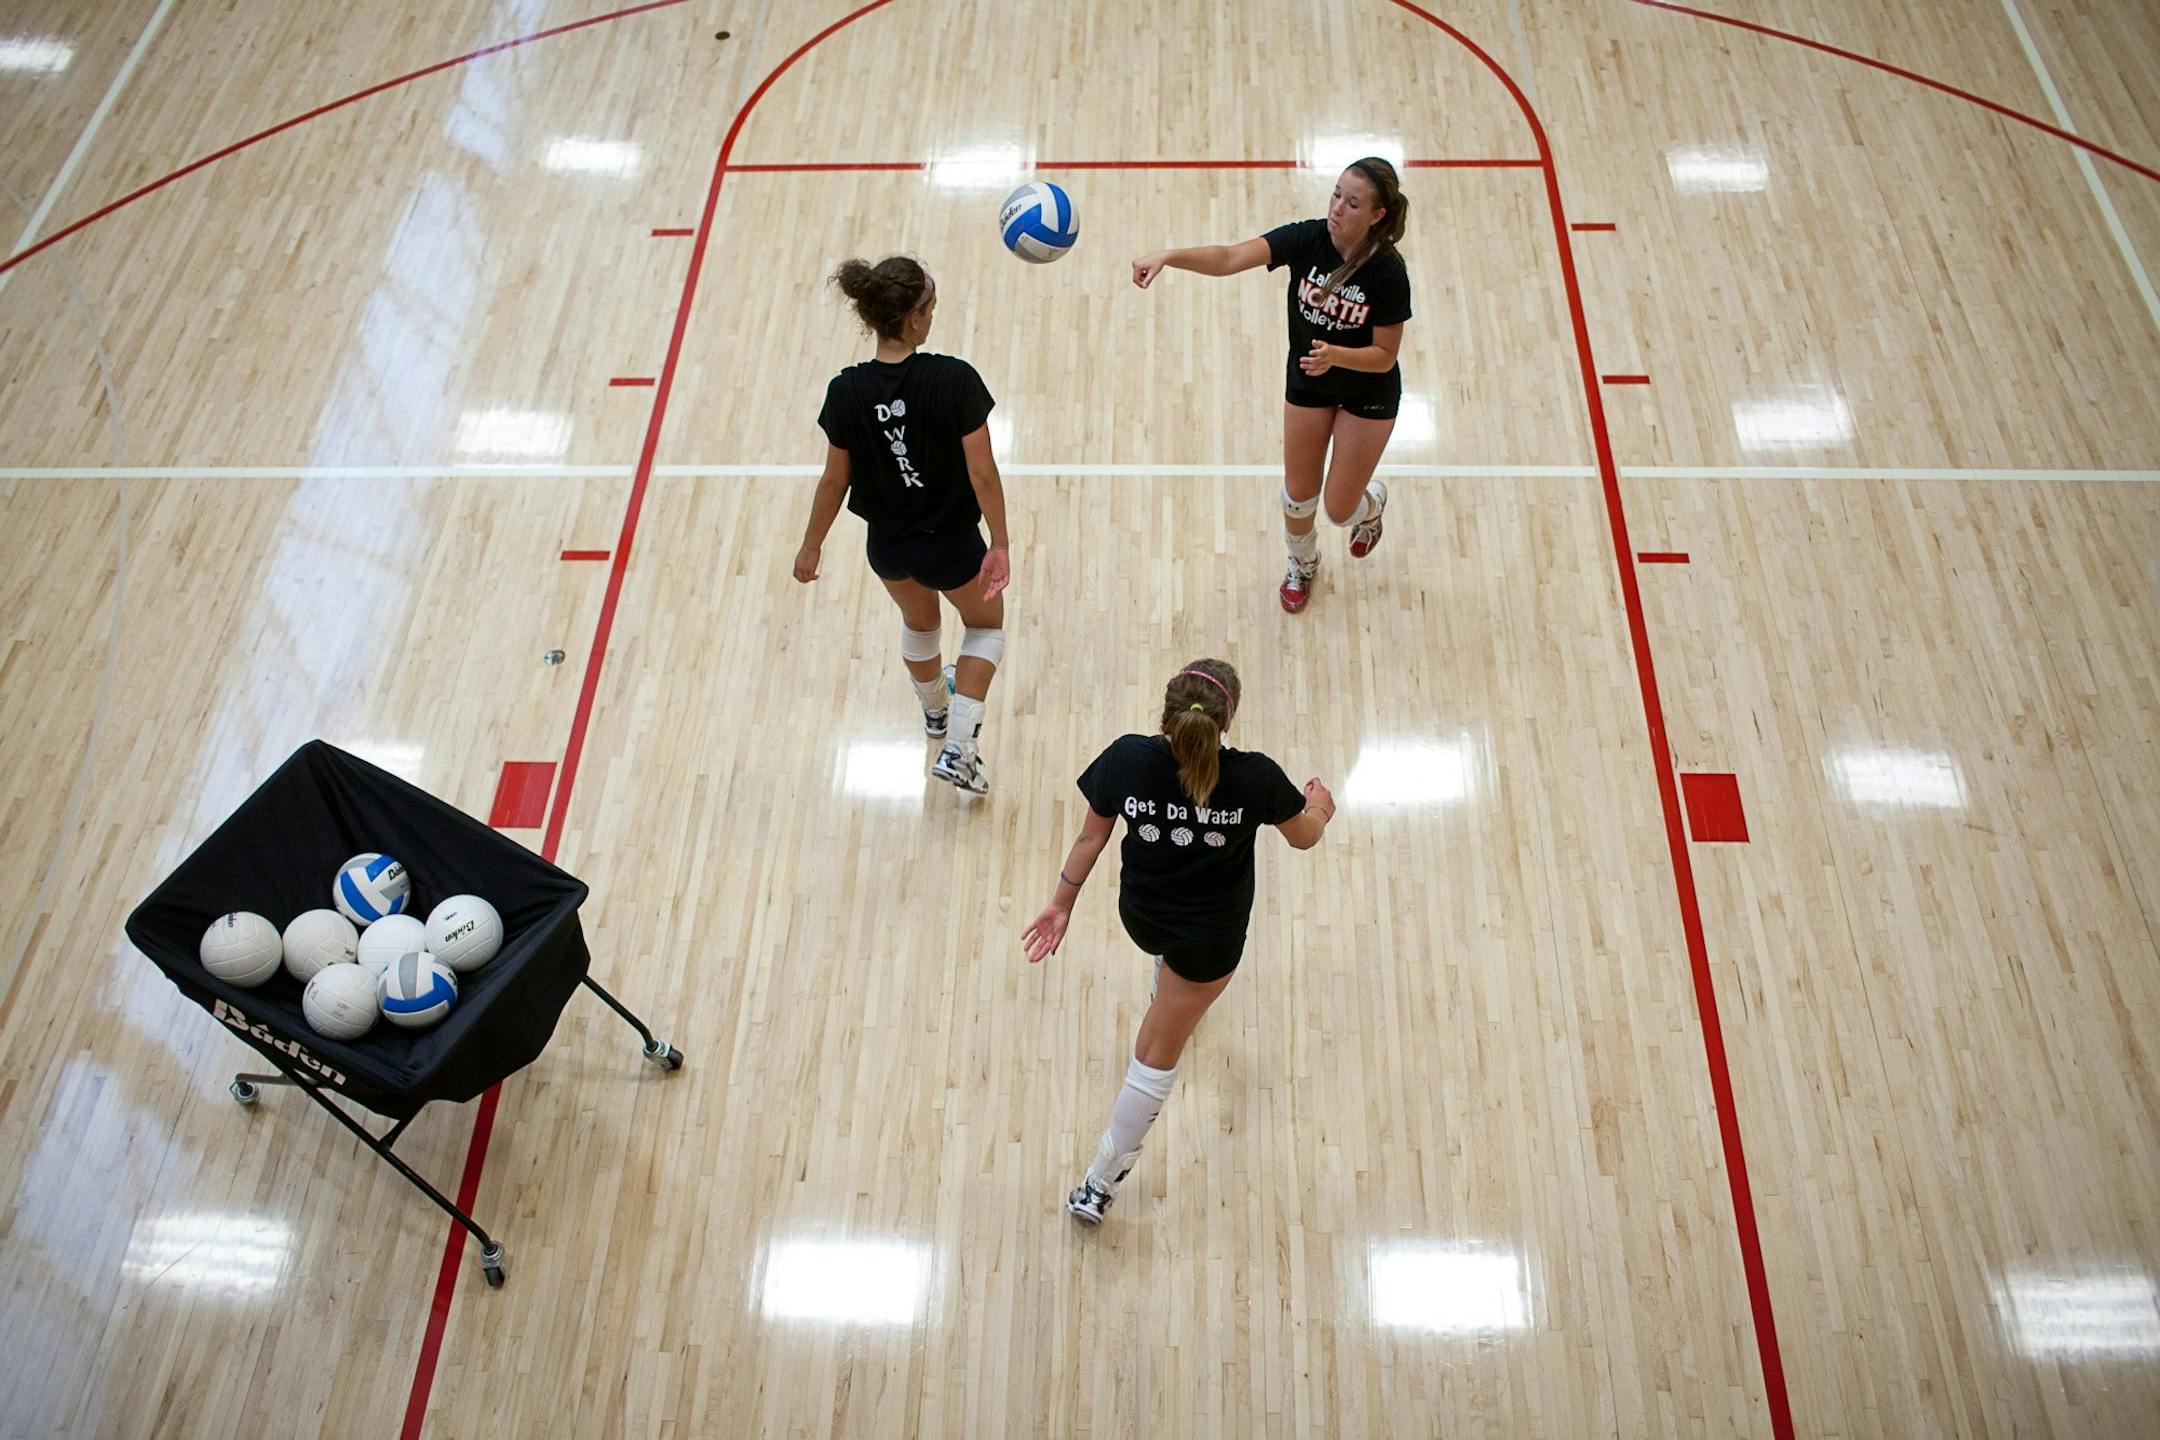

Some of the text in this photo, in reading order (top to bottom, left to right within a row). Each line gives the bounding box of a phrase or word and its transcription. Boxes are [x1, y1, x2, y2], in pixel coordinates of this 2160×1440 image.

[1297, 277, 1371, 325] NORTH
[1124, 796, 1156, 819] Get
[1167, 803, 1188, 820] Da
